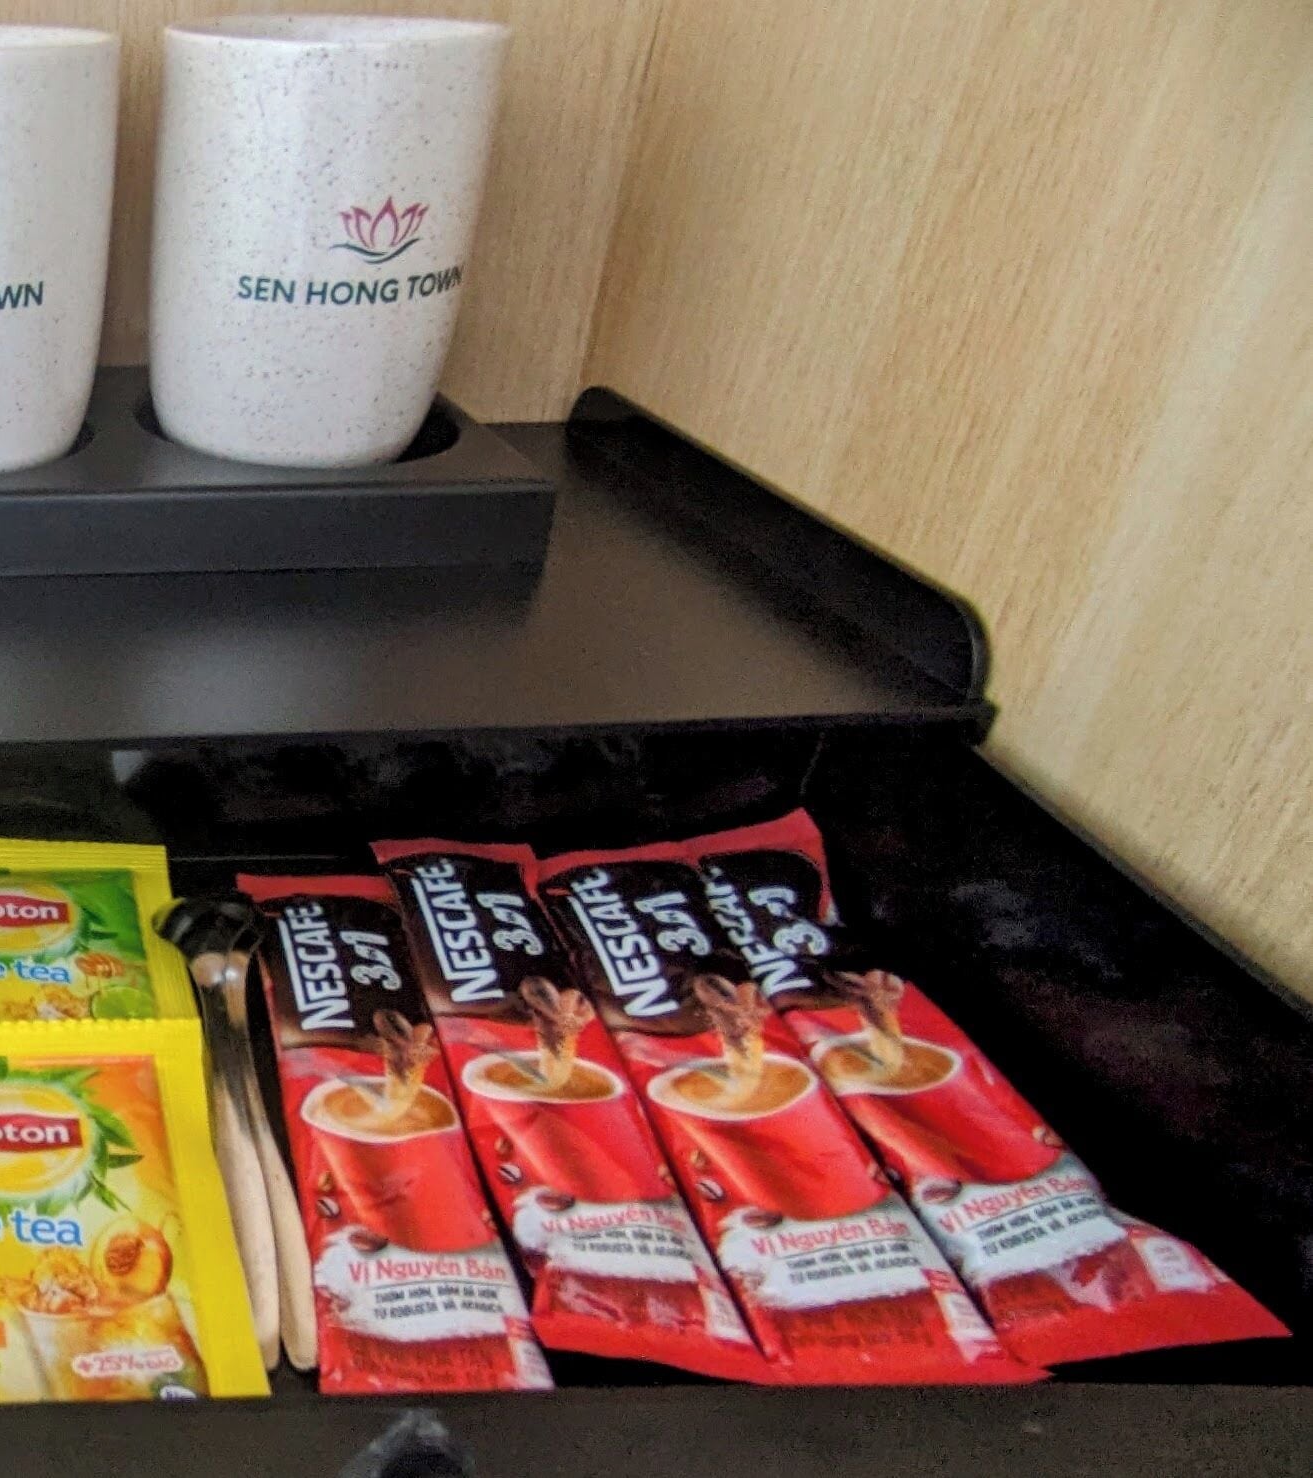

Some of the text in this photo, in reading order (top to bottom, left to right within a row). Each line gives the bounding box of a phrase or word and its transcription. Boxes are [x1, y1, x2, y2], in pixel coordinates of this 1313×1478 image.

[237, 265, 464, 305] SEN HONG TOWN
[14, 958, 71, 983] tea
[13, 1208, 83, 1247] tea
[348, 1260, 370, 1285] Vị
